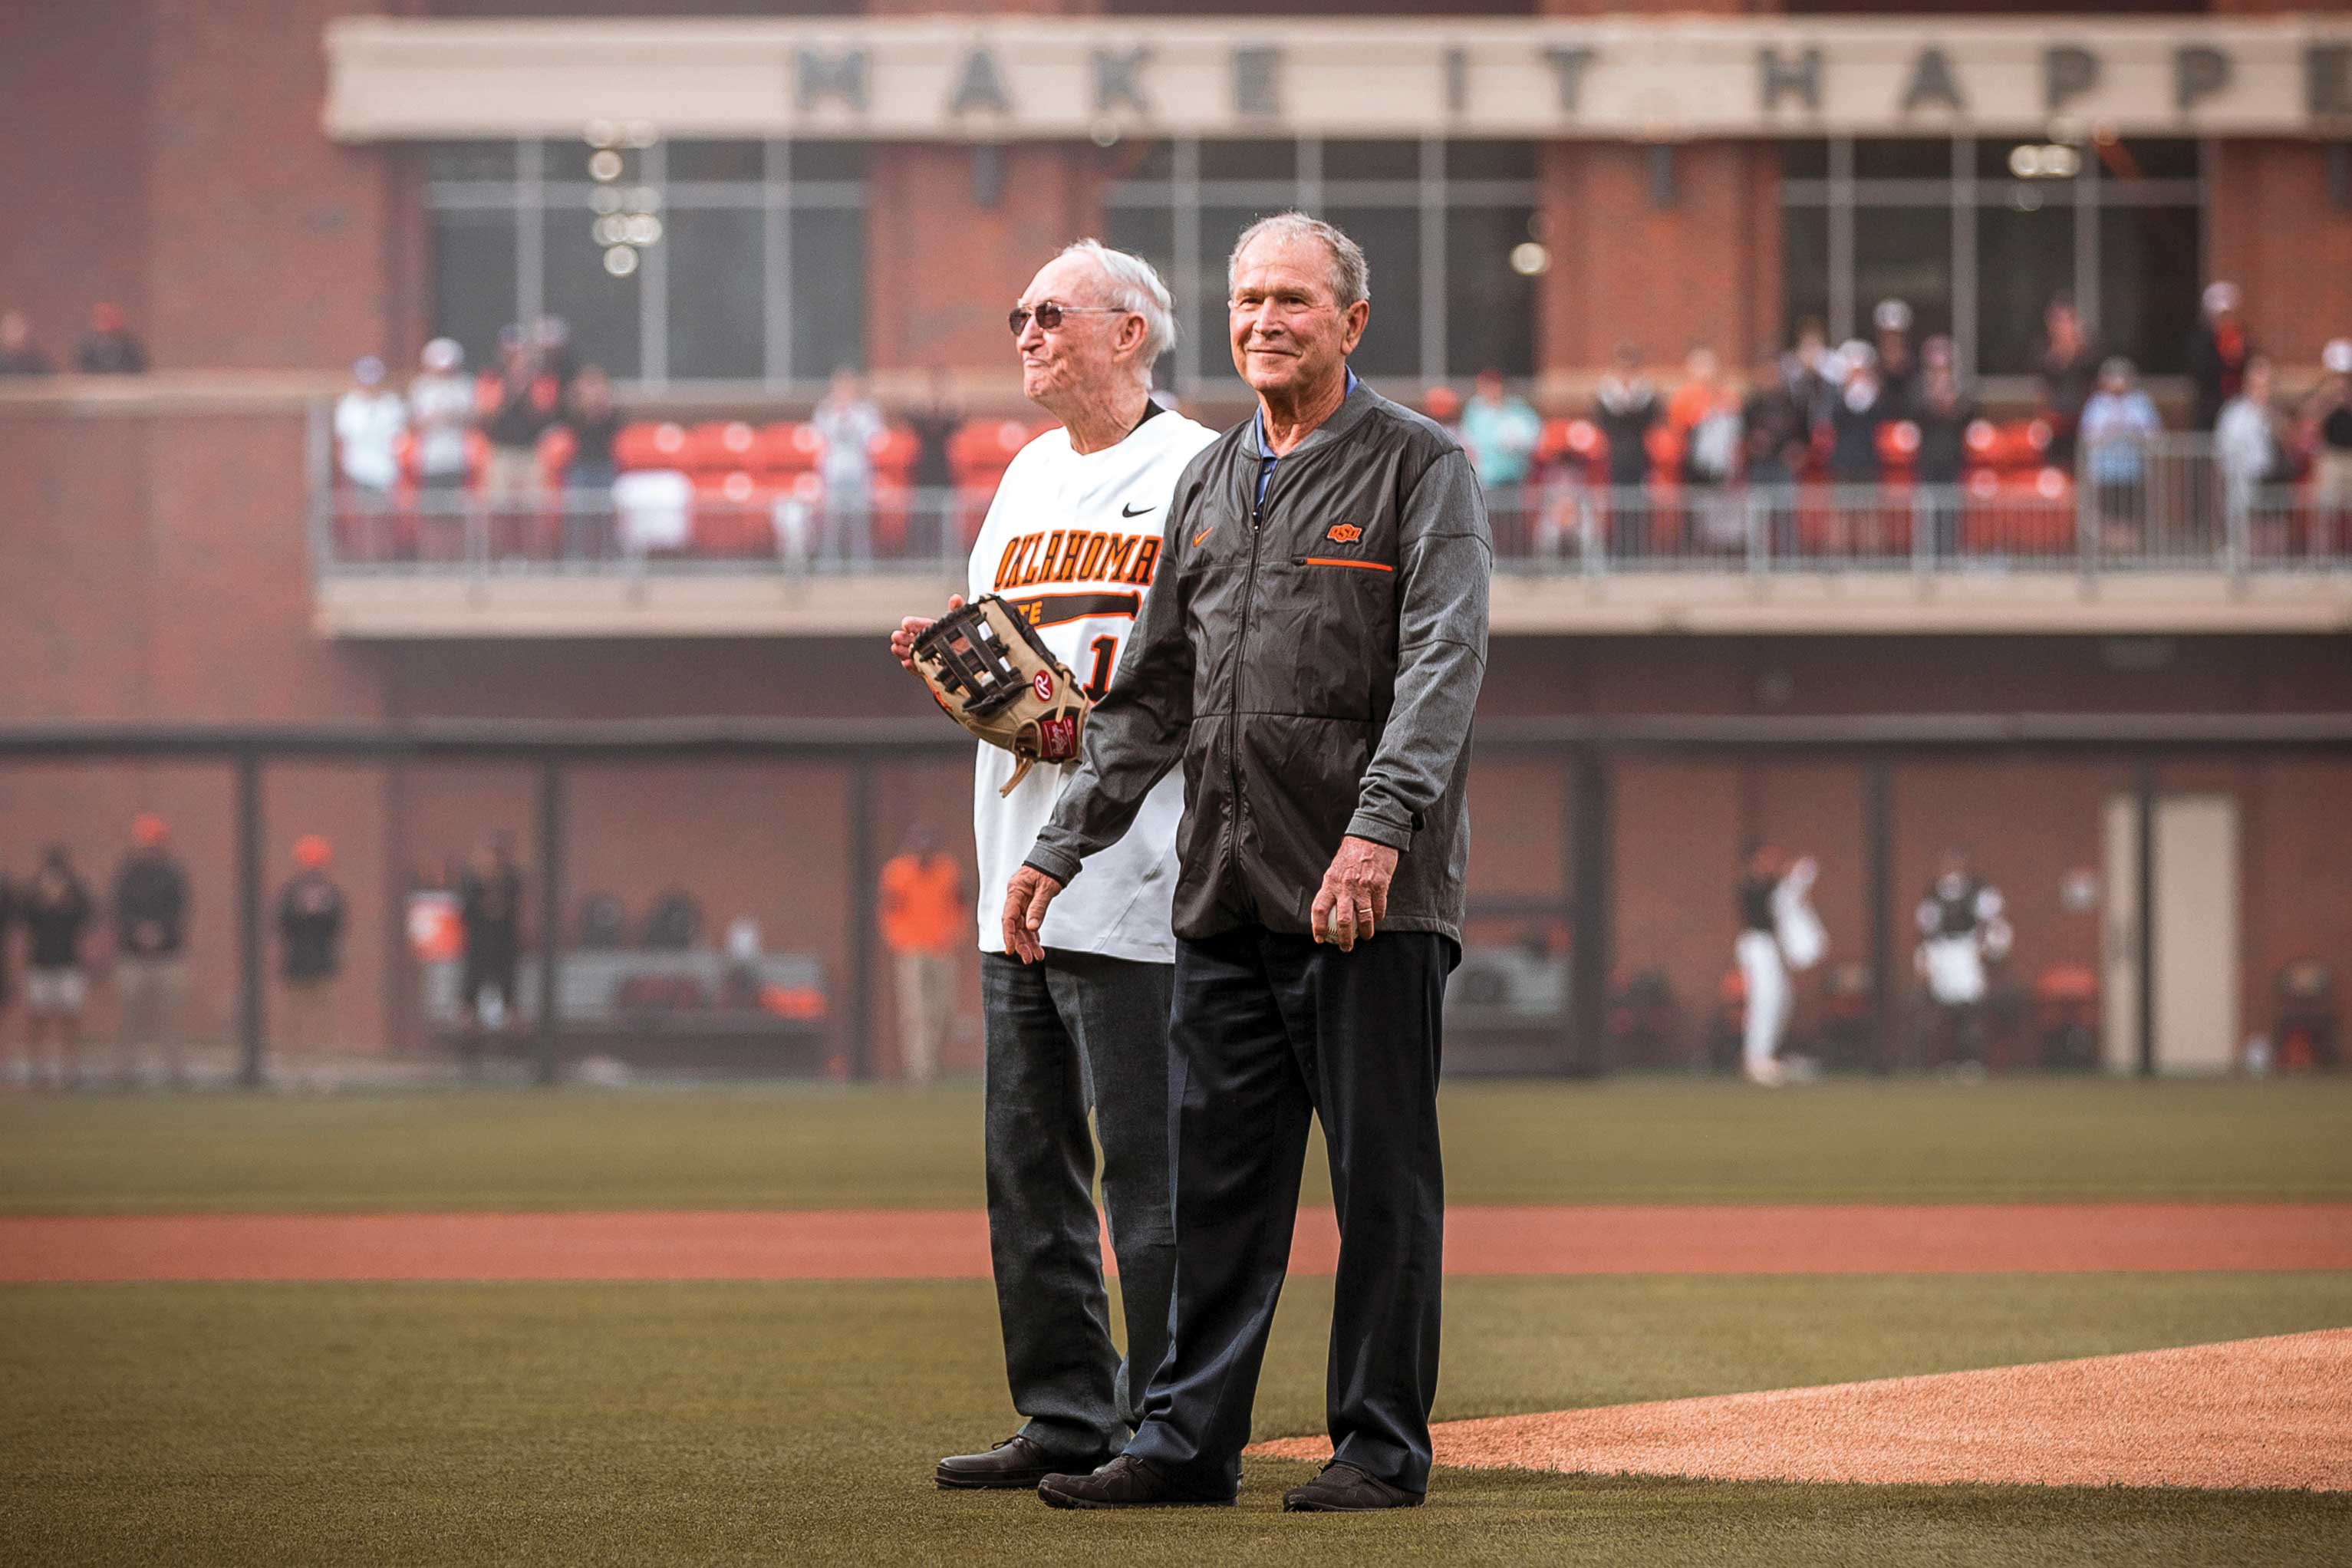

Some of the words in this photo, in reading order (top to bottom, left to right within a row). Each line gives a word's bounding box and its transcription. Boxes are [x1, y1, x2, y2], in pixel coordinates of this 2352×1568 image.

[793, 47, 1283, 114] MAKE
[1444, 47, 1596, 114] IT
[993, 529, 1163, 591] OKLAHOMA
